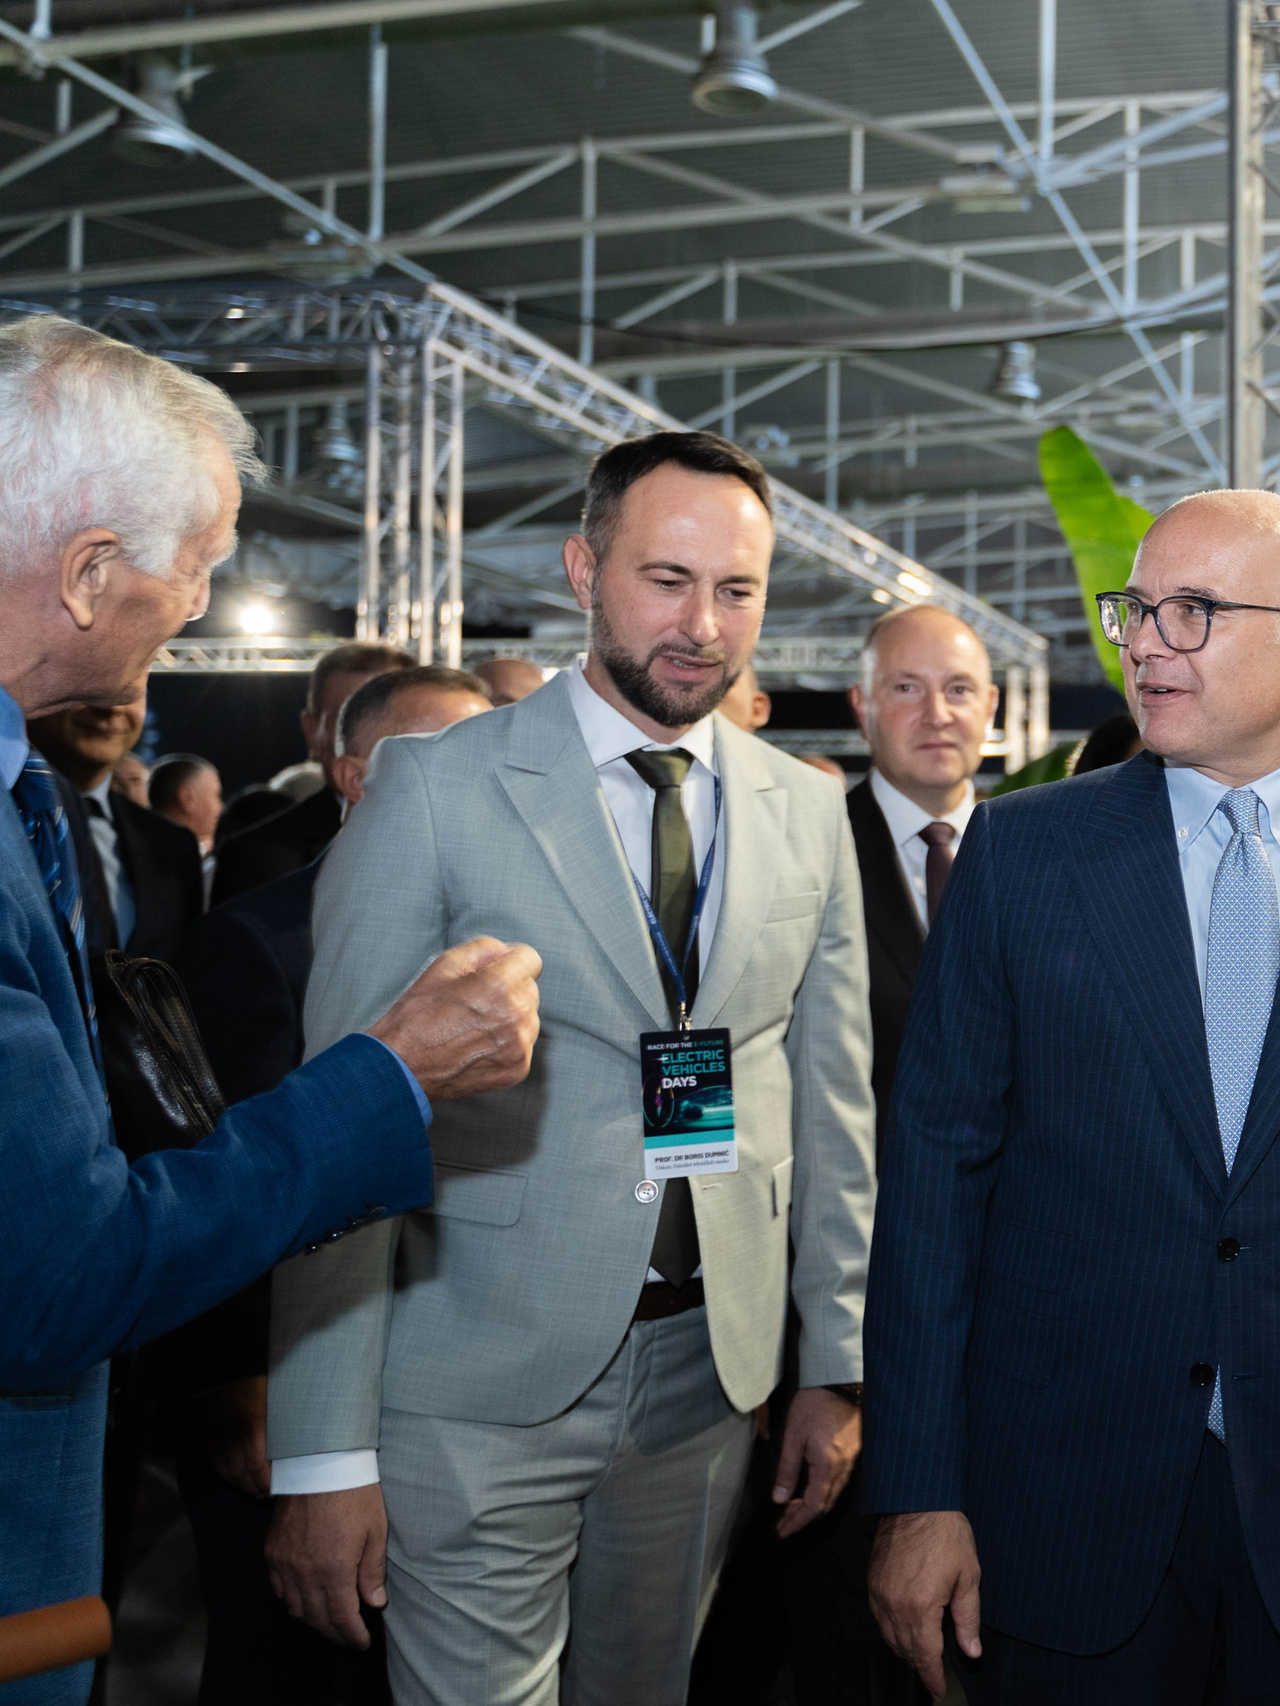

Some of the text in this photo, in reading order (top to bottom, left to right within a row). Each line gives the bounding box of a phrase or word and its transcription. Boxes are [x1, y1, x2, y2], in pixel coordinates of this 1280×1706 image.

[662, 1049, 724, 1063] ELECTRIC
[662, 1062, 725, 1075] VEHICLES
[662, 1076, 697, 1088] DAYS
